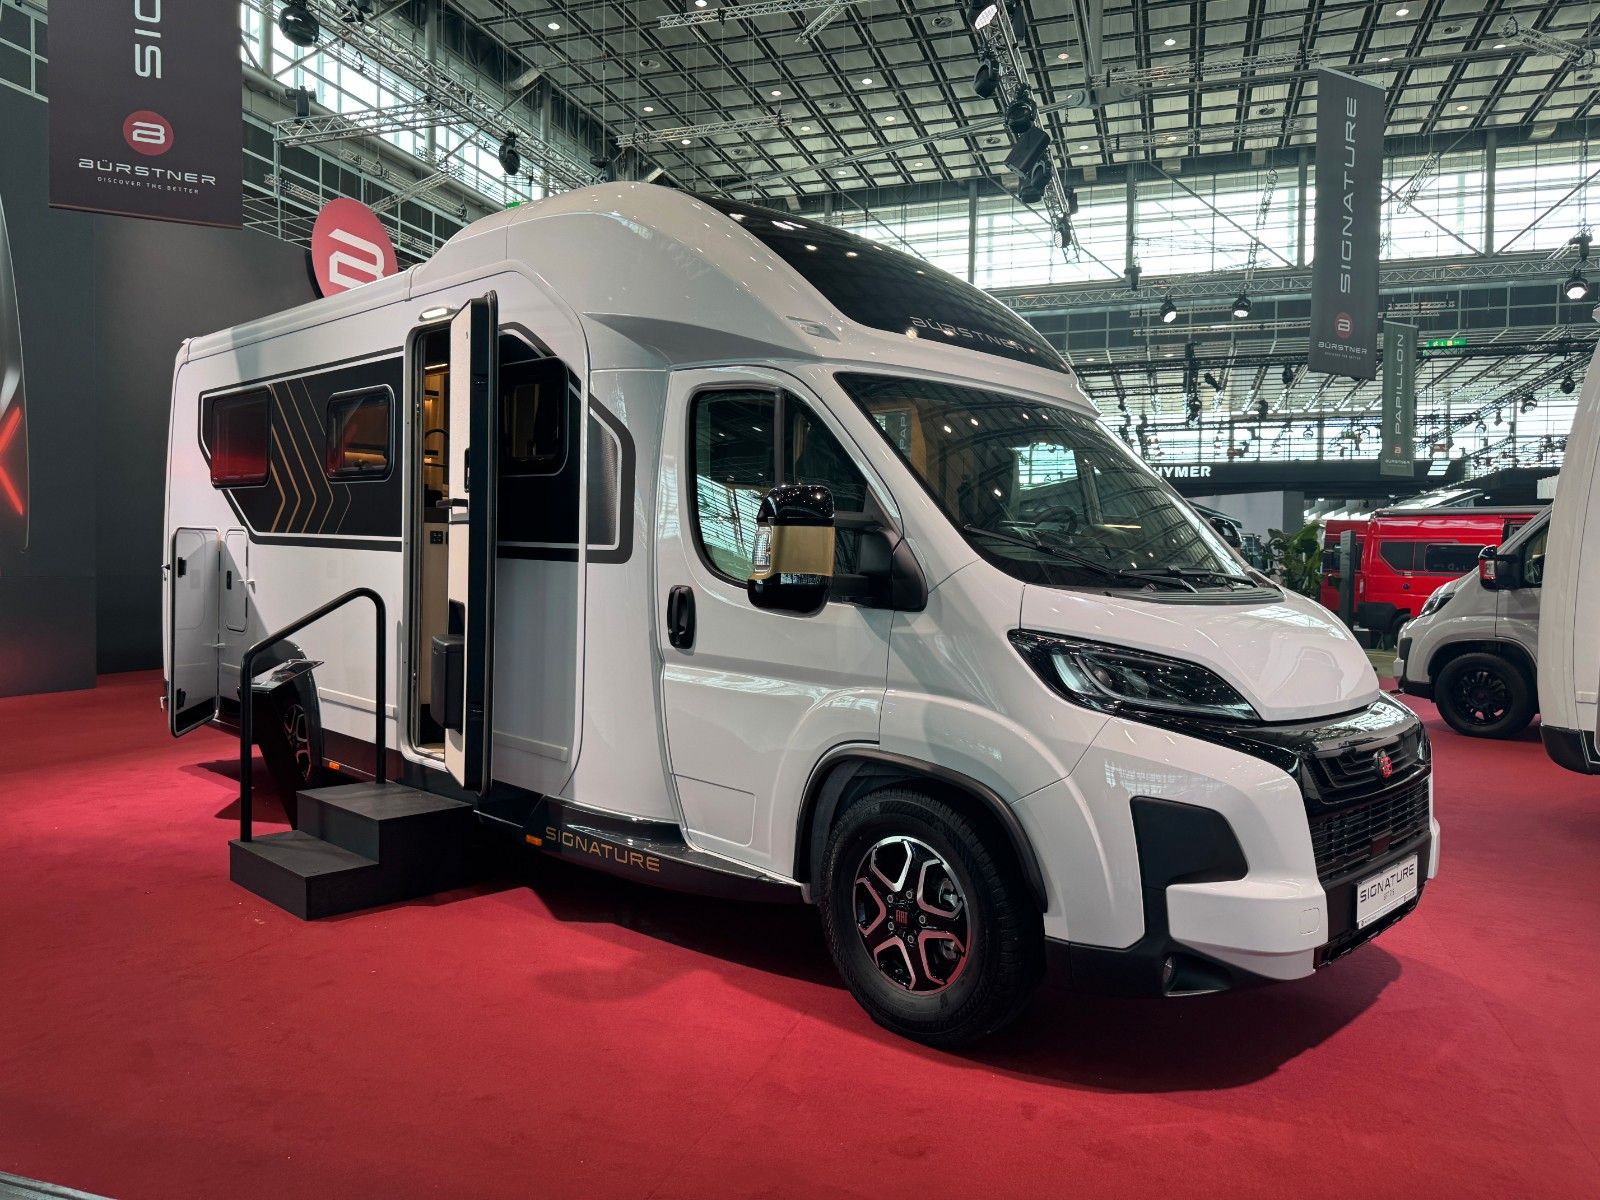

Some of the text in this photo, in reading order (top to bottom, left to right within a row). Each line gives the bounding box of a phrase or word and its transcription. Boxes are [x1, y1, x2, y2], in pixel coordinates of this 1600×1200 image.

[78, 158, 216, 186] BÜRSTNER
[97, 176, 199, 195] DISCOVER THE BETTER
[1340, 96, 1357, 294] SIGNATURE
[1395, 334, 1404, 435] PAPILLON
[1152, 465, 1212, 478] HYMER
[545, 826, 660, 873] SIGNATURE
[1360, 863, 1415, 904] SIGNATURE
